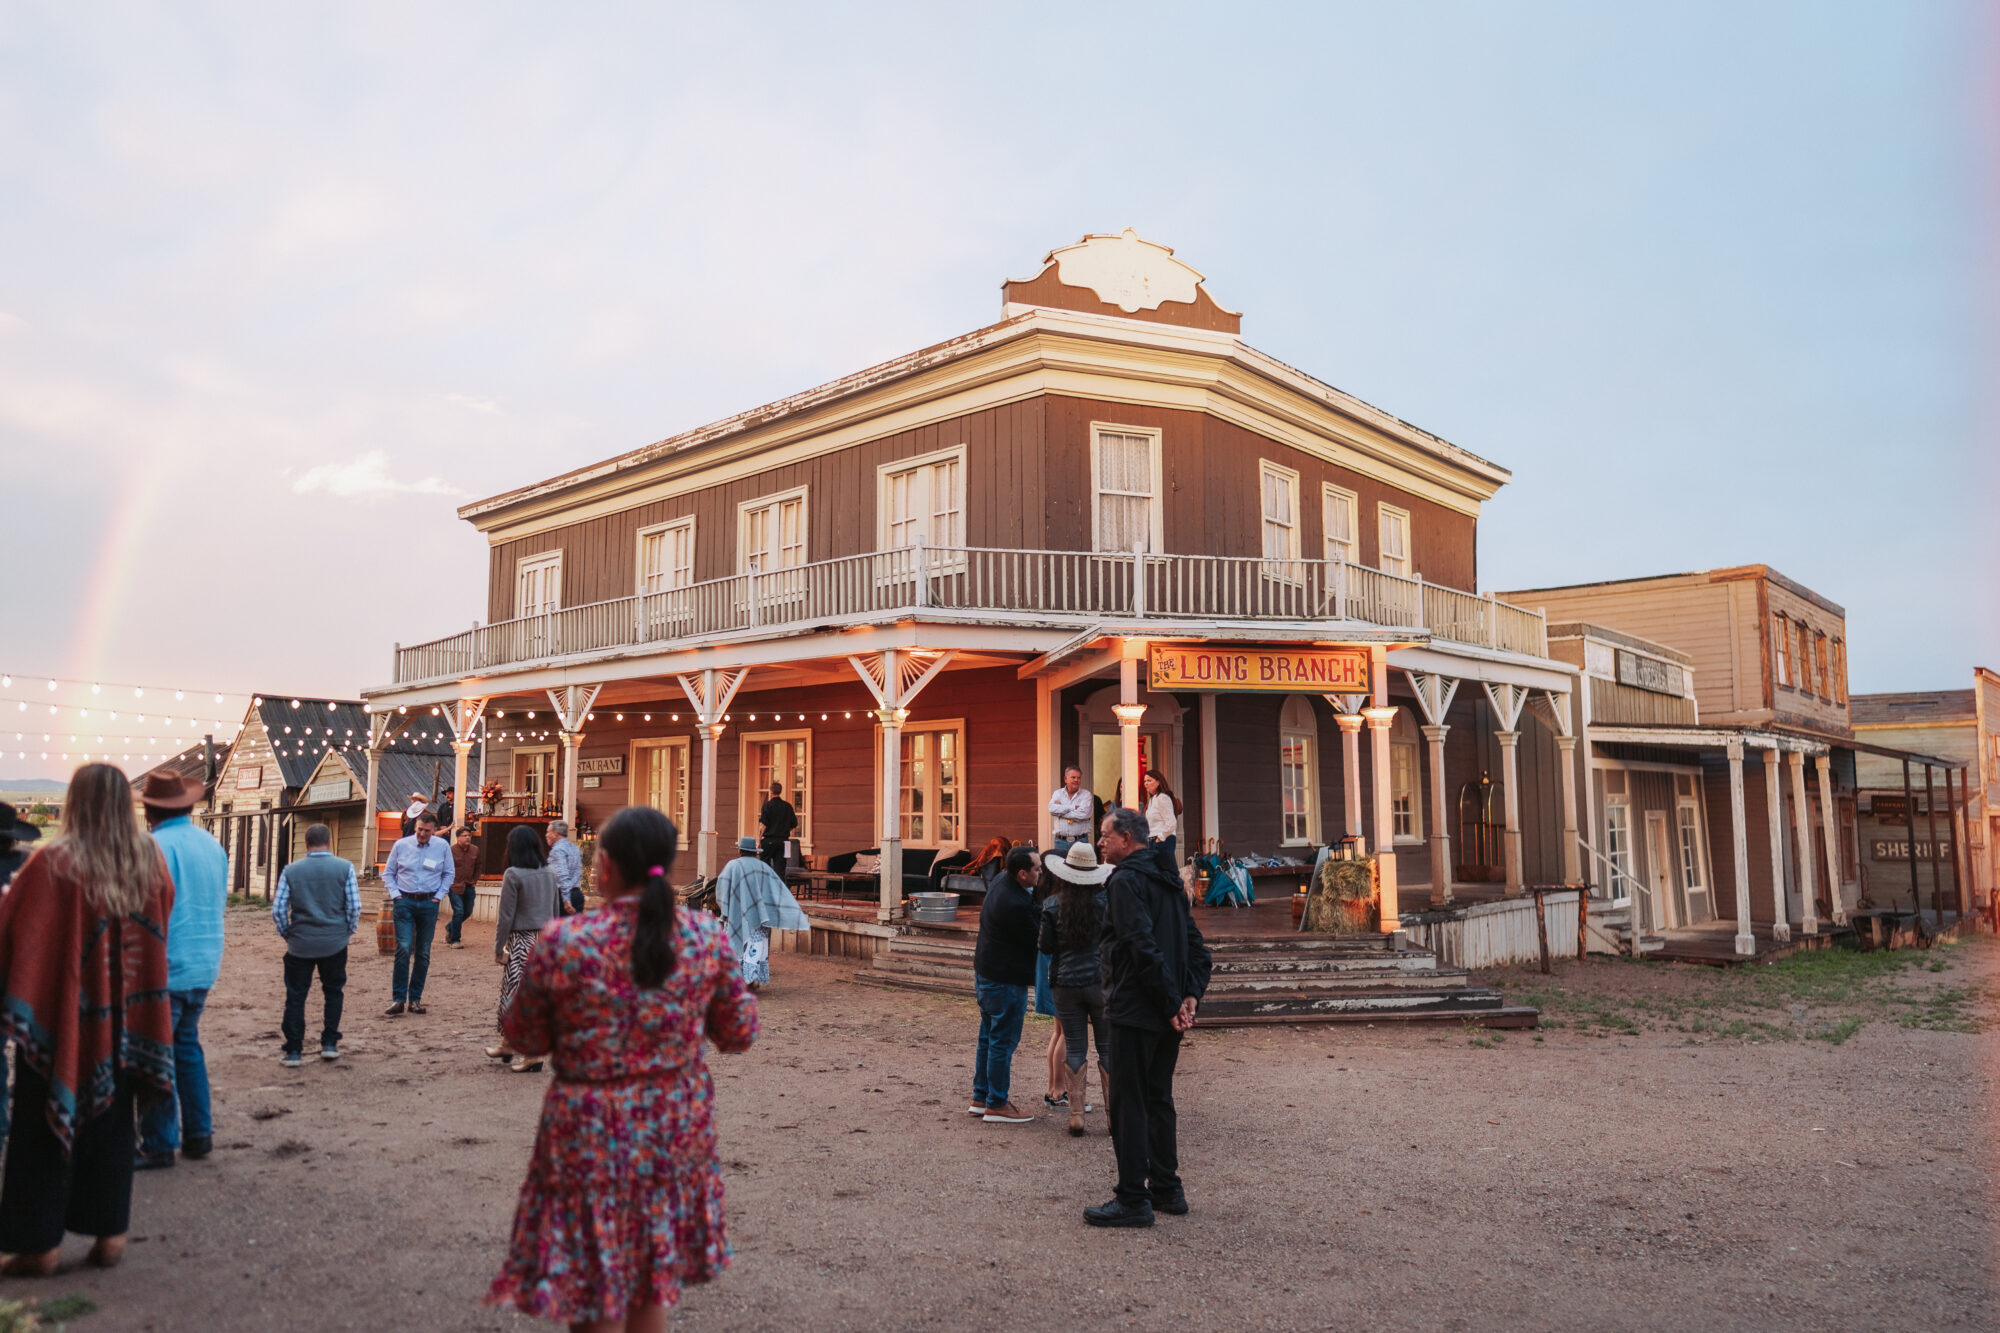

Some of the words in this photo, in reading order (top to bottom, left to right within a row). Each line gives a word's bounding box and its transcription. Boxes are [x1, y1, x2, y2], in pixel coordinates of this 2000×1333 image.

[1158, 659, 1175, 670] THE
[1180, 655, 1248, 681] LONG
[1259, 656, 1356, 683] BRANCH
[577, 759, 620, 771] STAURANT
